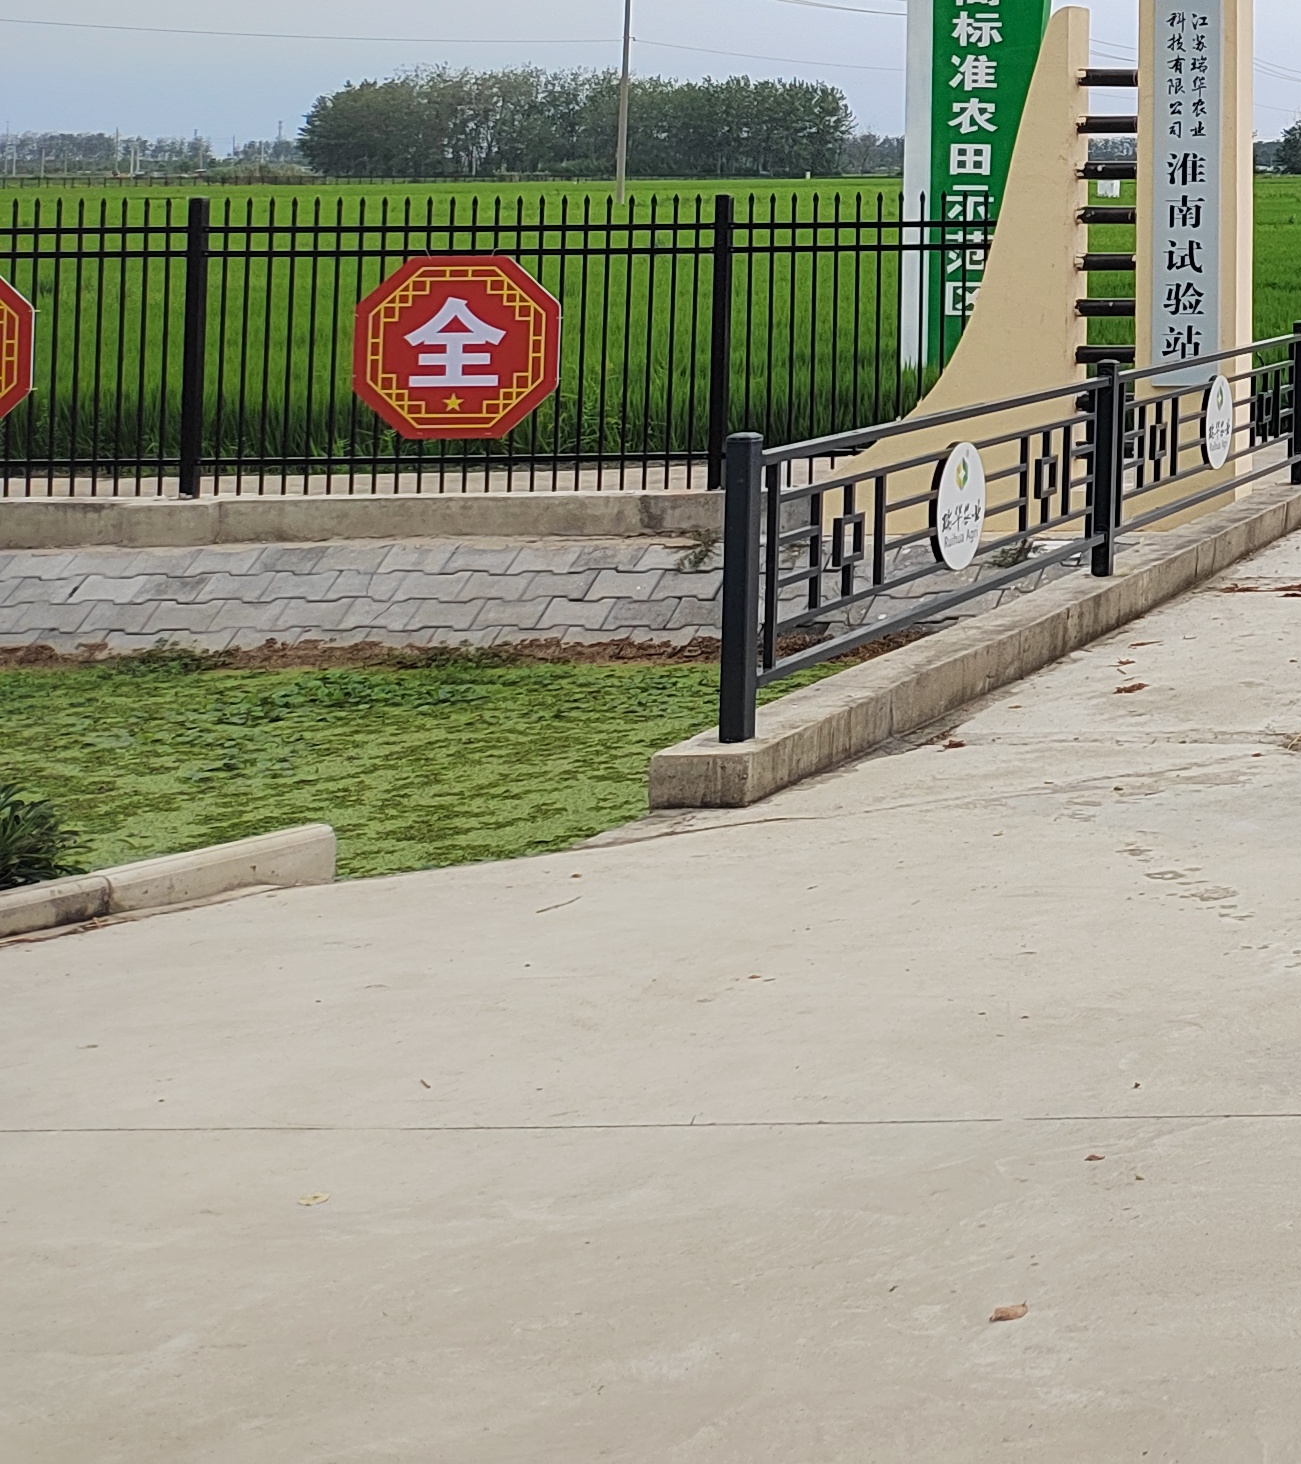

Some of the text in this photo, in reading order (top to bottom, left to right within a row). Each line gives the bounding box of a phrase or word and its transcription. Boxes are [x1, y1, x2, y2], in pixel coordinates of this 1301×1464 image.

[1166, 11, 1187, 139] 科技有限公司
[1189, 13, 1209, 137] 江苏瑞华农业
[1161, 152, 1207, 360] 淮南试验站
[404, 297, 507, 387] 全
